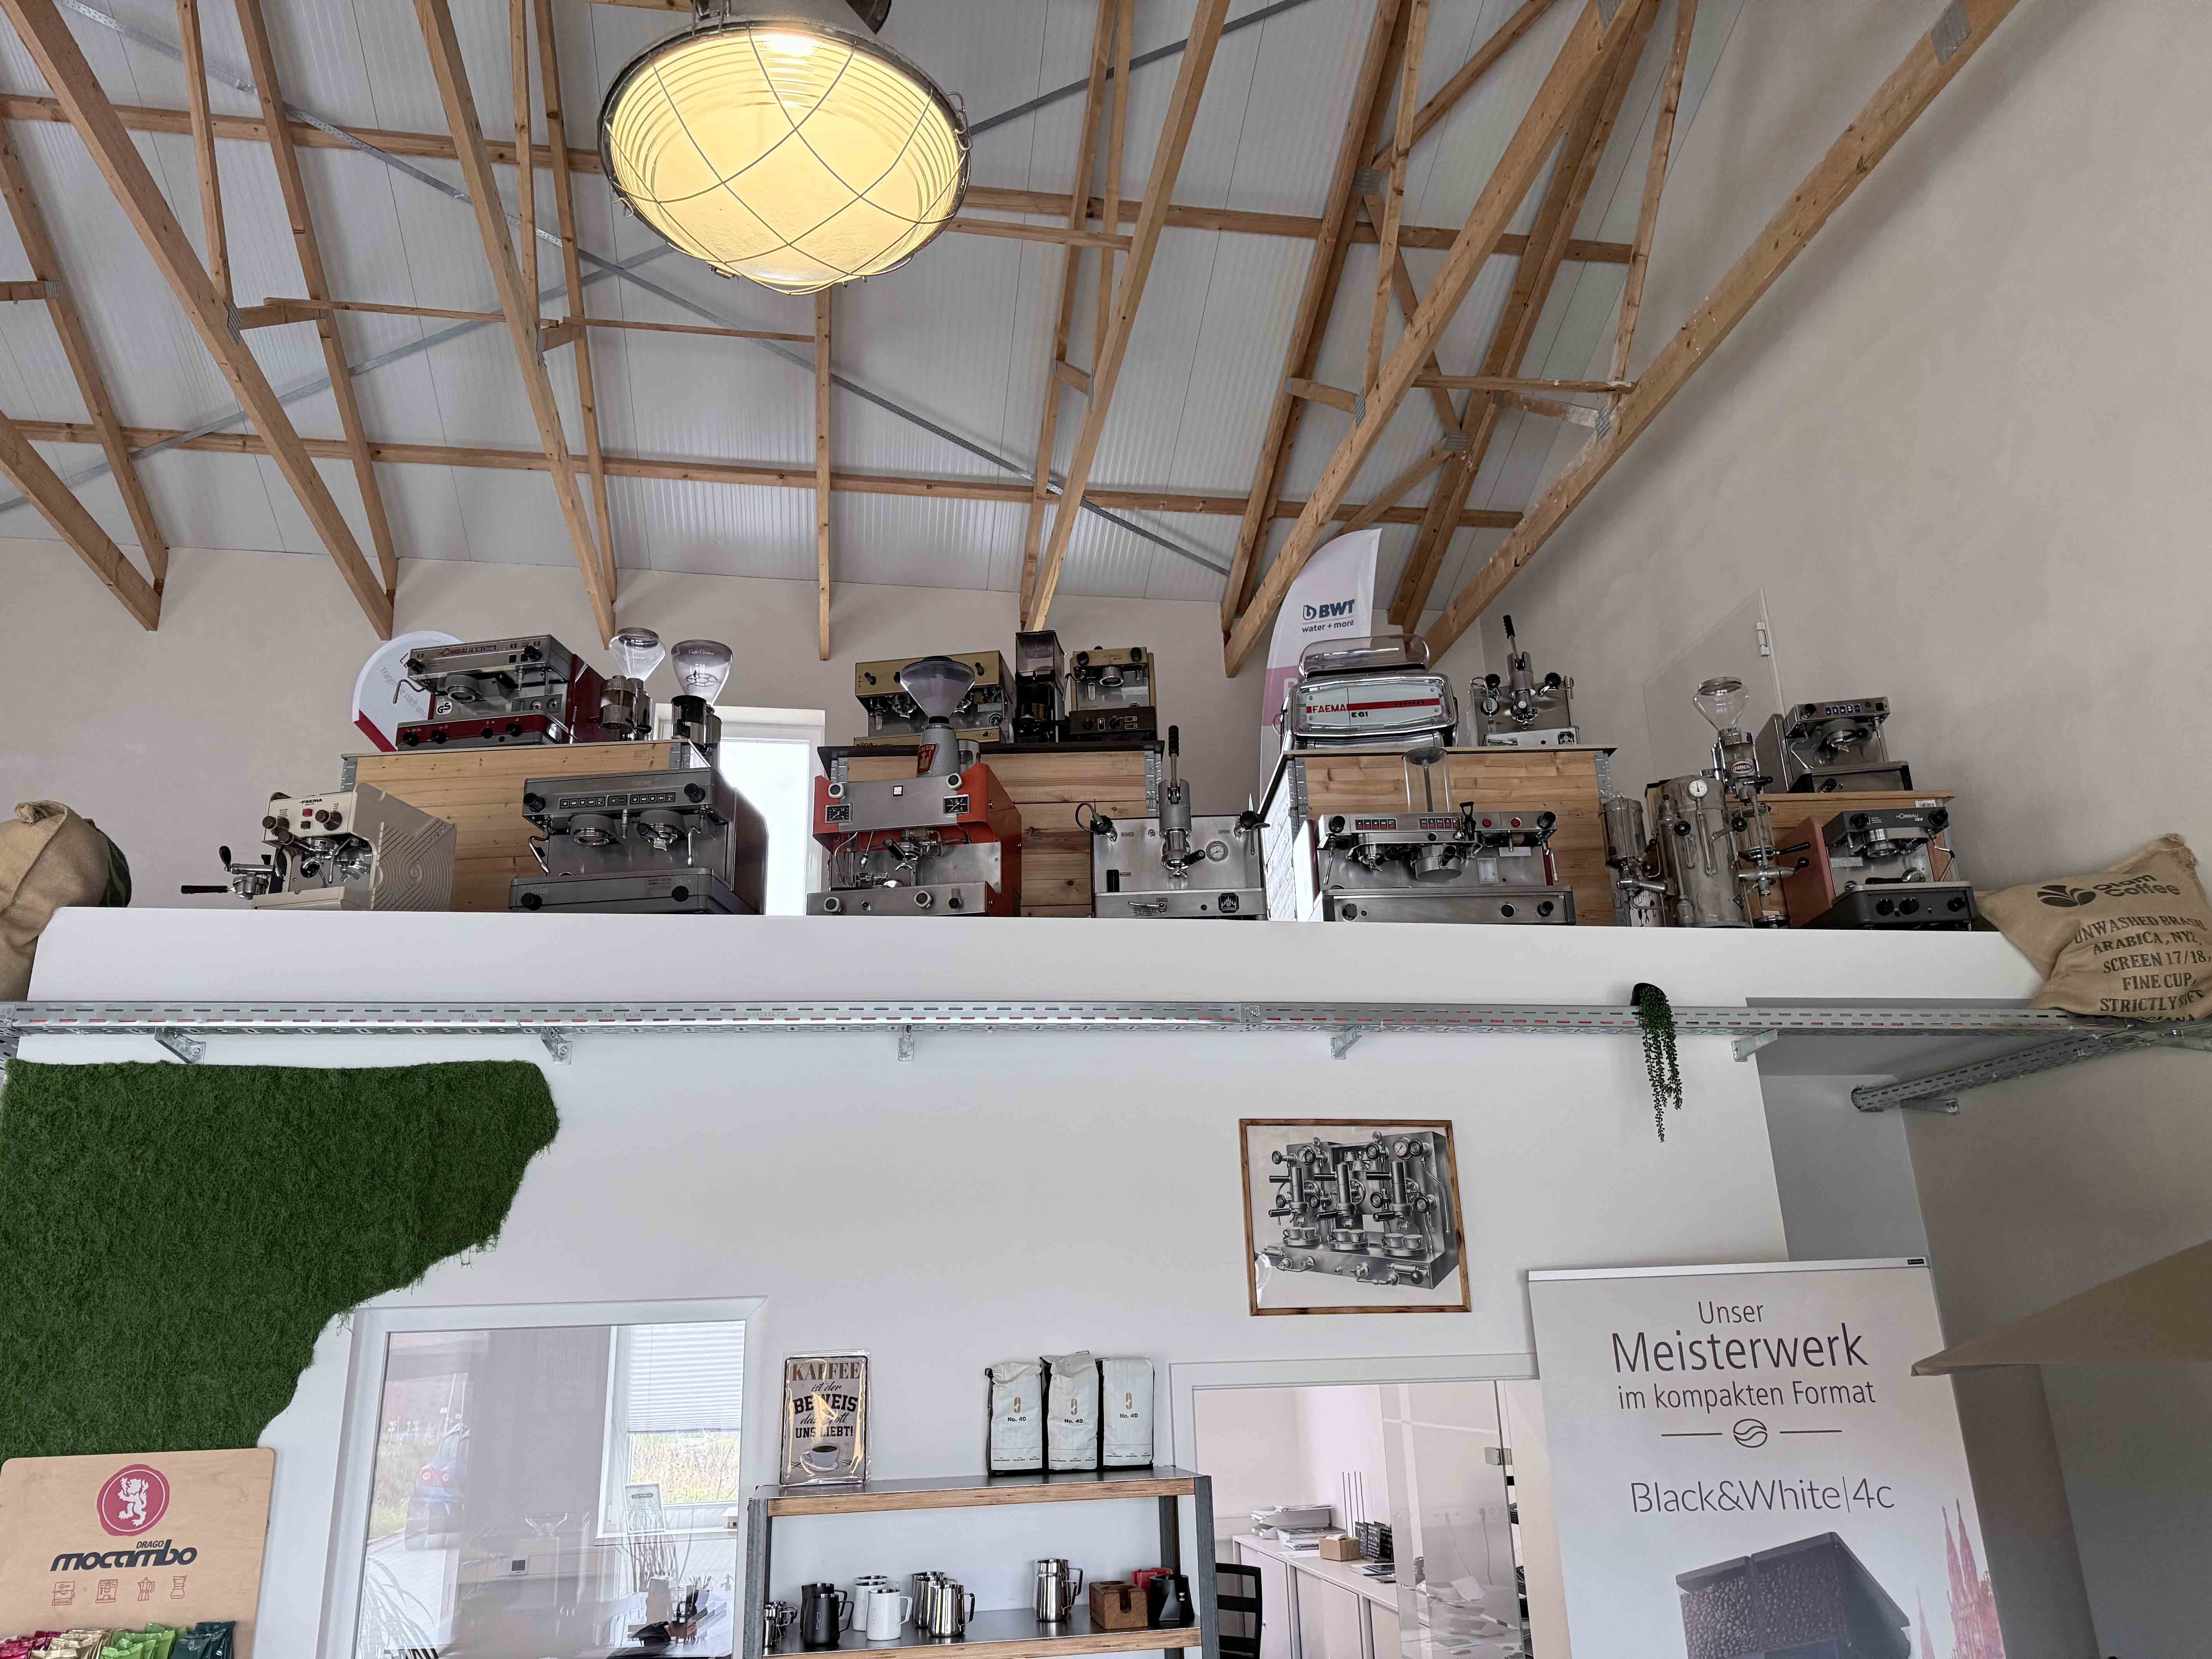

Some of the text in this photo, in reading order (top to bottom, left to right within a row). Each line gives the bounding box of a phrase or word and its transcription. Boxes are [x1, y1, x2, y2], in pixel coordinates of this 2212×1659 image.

[1319, 599, 1355, 618] BWT
[1302, 624, 1326, 633] water
[1334, 620, 1354, 629] more
[405, 694, 418, 709] nach
[437, 702, 451, 713] GS
[1312, 704, 1346, 713] FAEMA
[2093, 874, 2157, 890] Olam
[2104, 883, 2181, 897] Coffee
[2075, 915, 2159, 944] UNWASHED
[2094, 931, 2169, 955] ARABICA,
[2103, 952, 2163, 974] SCREEN
[2122, 972, 2197, 991] FINE CUP,
[2100, 996, 2178, 1012] STRICTLY
[1698, 1301, 1764, 1324] Unser
[1612, 1322, 1869, 1373] Meisterwerk
[792, 1362, 860, 1381] KAFFEE
[811, 1381, 842, 1392] ist der
[1618, 1380, 1876, 1414] im kompakten Format
[136, 1540, 164, 1549] DRAGO
[50, 1539, 198, 1571] mocambo
